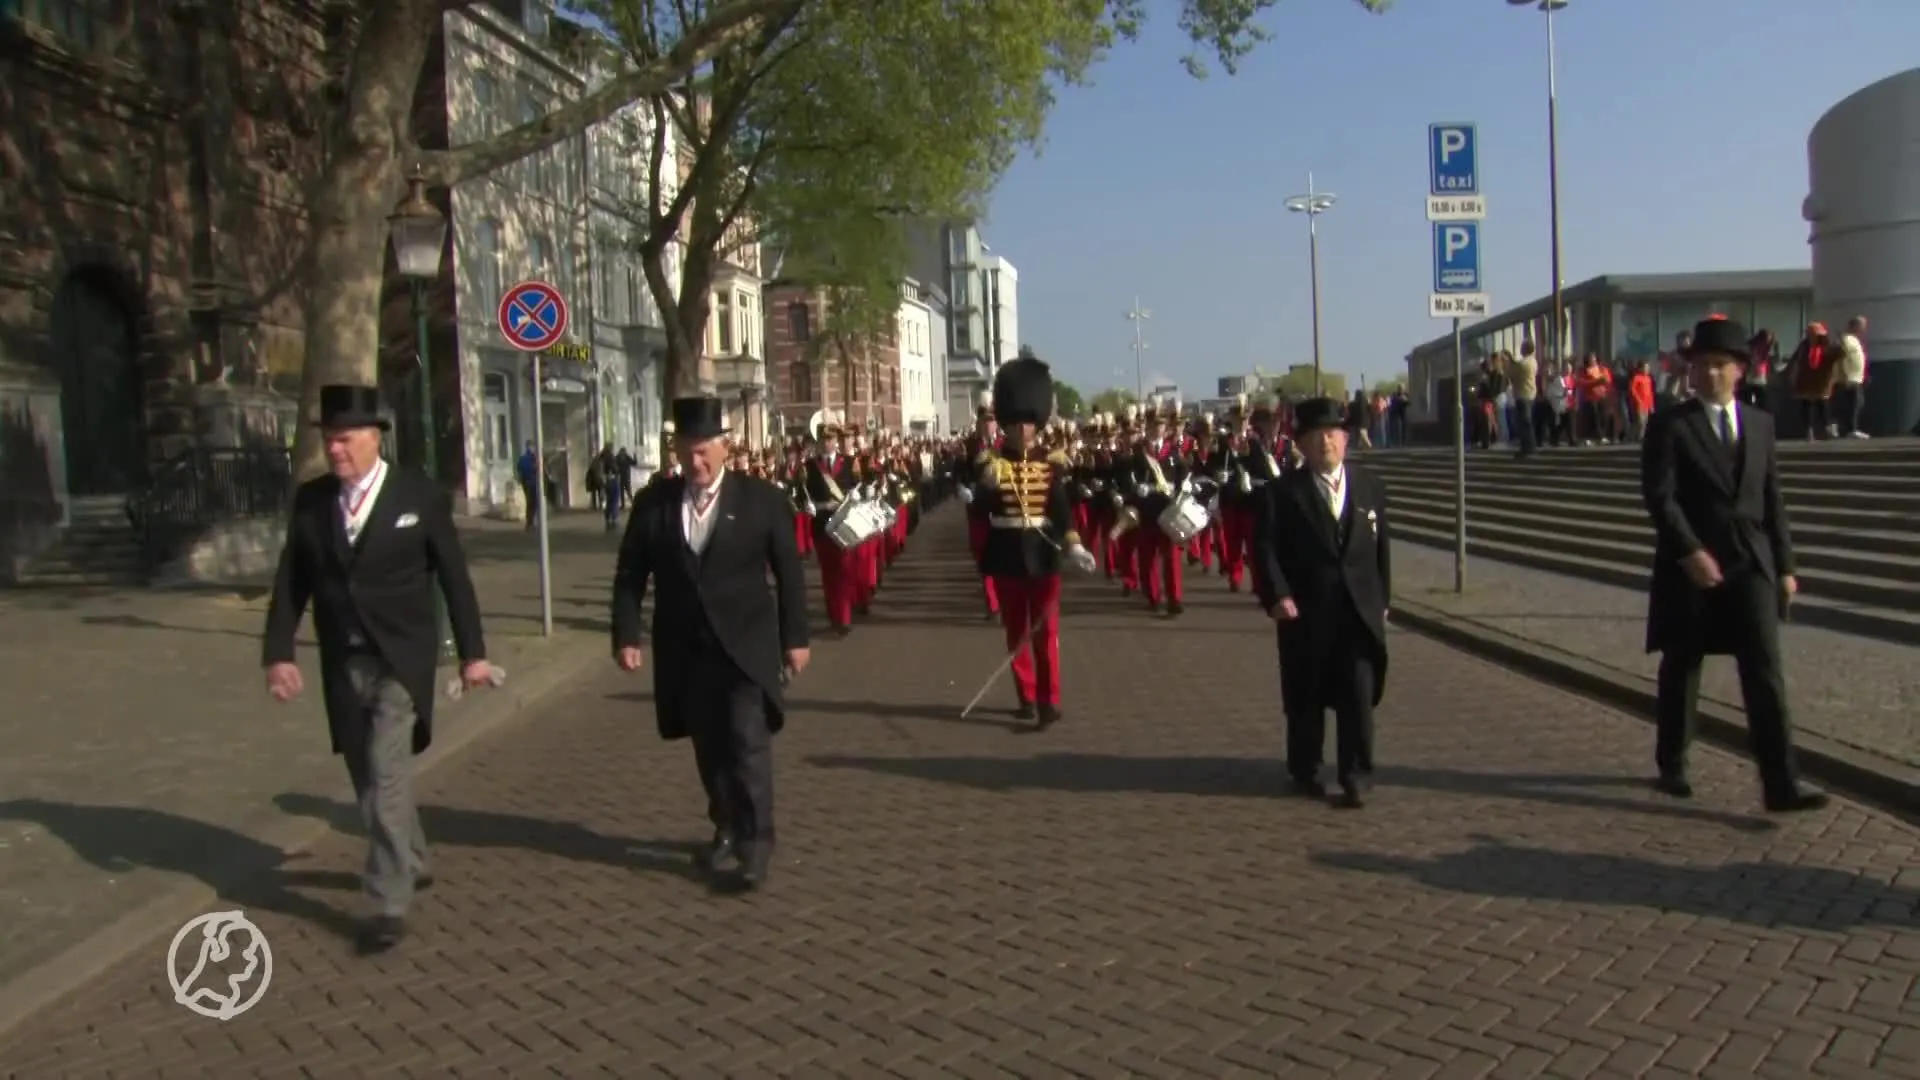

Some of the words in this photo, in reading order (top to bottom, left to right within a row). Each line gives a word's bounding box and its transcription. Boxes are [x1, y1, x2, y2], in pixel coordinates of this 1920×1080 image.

[1440, 128, 1465, 165] P
[1439, 173, 1472, 188] taxi
[1445, 227, 1469, 262] P
[1434, 298, 1452, 311] Max
[1455, 298, 1465, 311] 30
